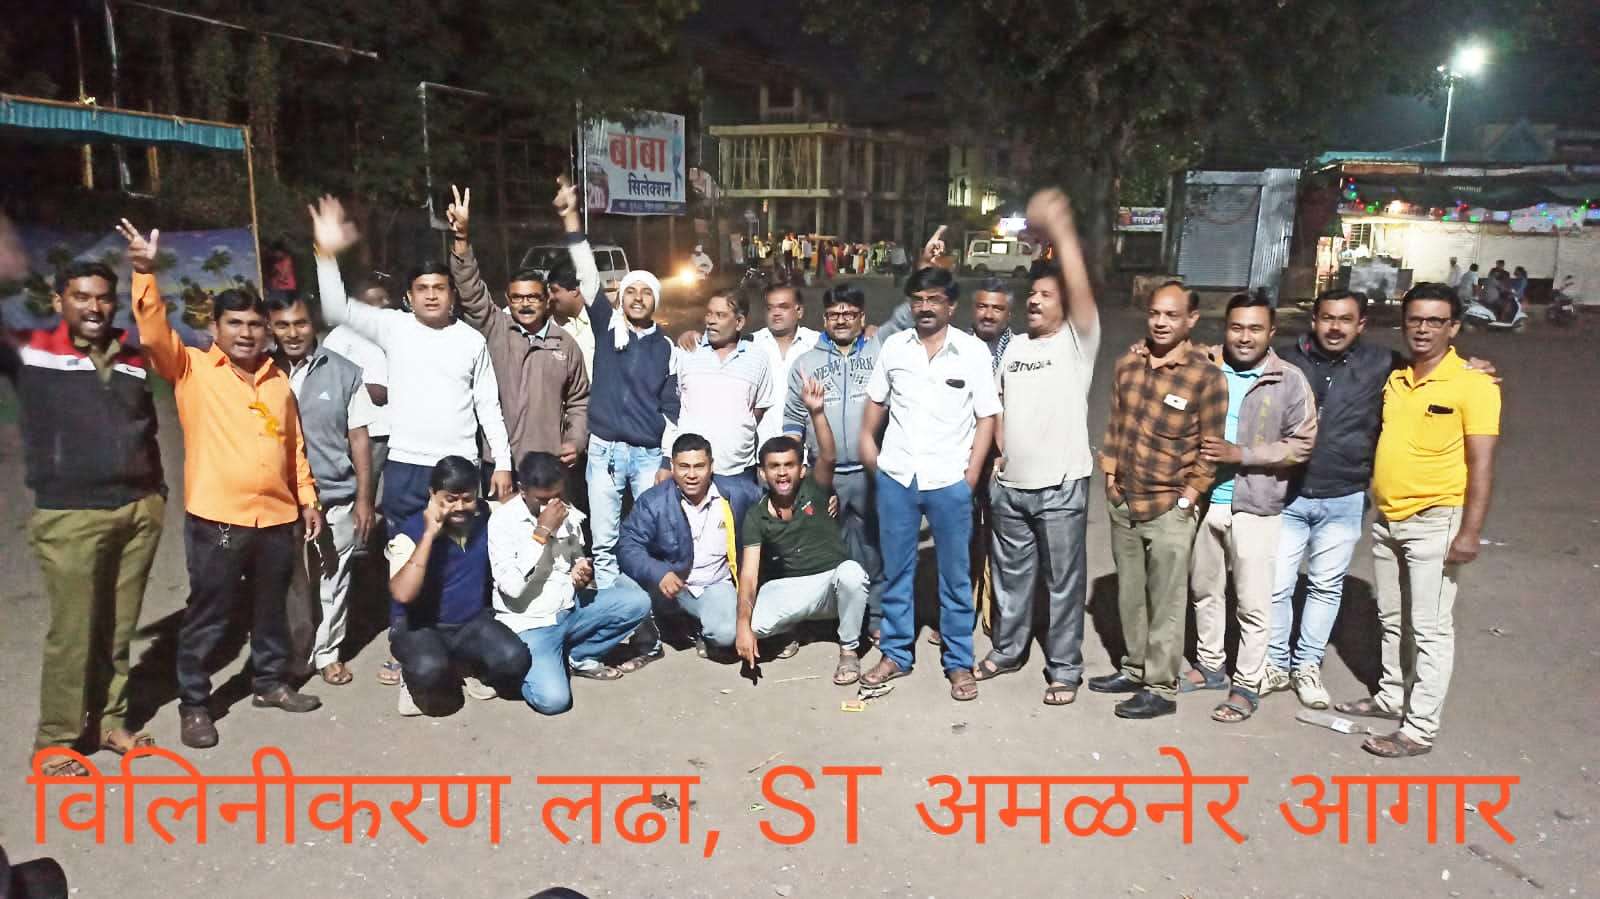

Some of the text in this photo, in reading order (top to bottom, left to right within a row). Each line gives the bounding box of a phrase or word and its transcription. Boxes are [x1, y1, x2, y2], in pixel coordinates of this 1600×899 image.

[608, 133, 667, 172] बाबा
[628, 172, 672, 197] सिलेक्शन
[814, 358, 841, 380] NEW
[850, 356, 874, 372] YORK
